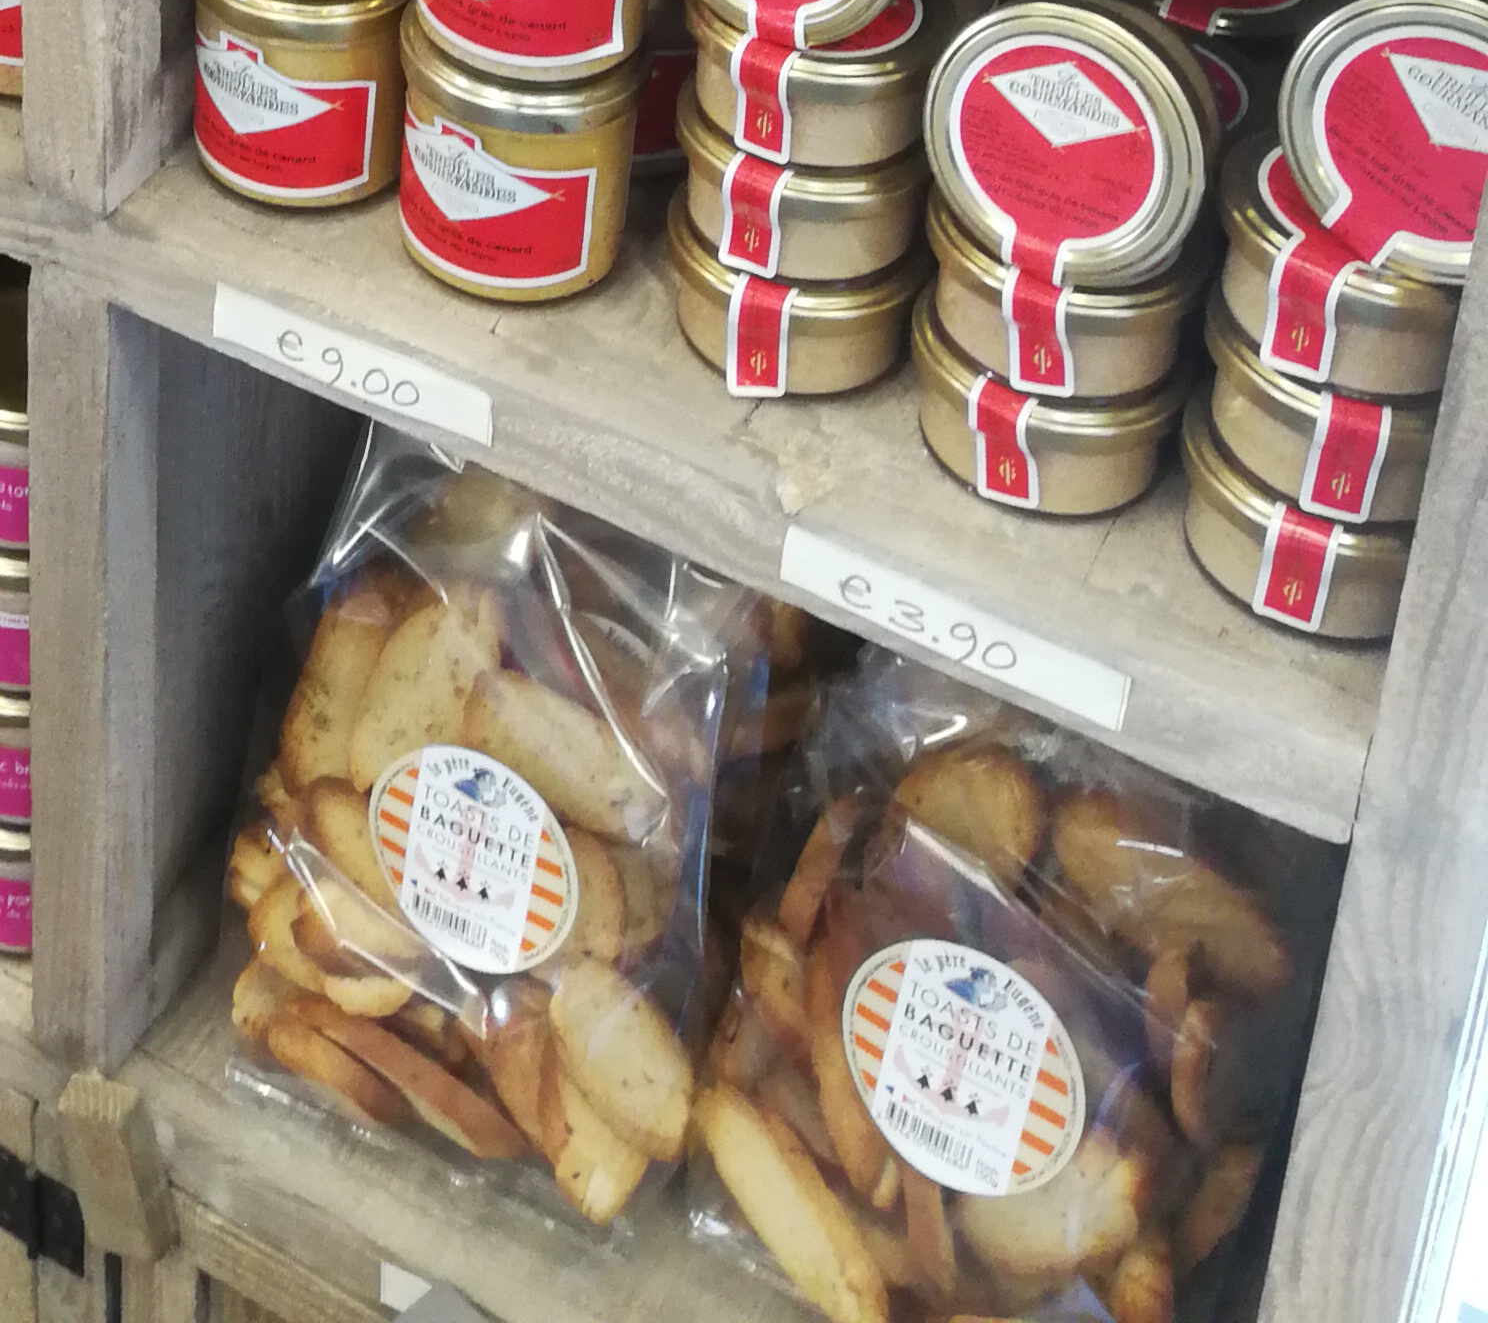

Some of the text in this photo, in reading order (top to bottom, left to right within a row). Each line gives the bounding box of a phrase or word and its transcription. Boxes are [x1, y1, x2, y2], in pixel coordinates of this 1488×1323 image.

[1007, 81, 1120, 128] GOURMANDES
[420, 806, 530, 869] BAGUETTE
[424, 785, 534, 848] TOASTS DE
[904, 1003, 1031, 1082] BAGUETTE
[911, 981, 1038, 1058] TOASTS DE
